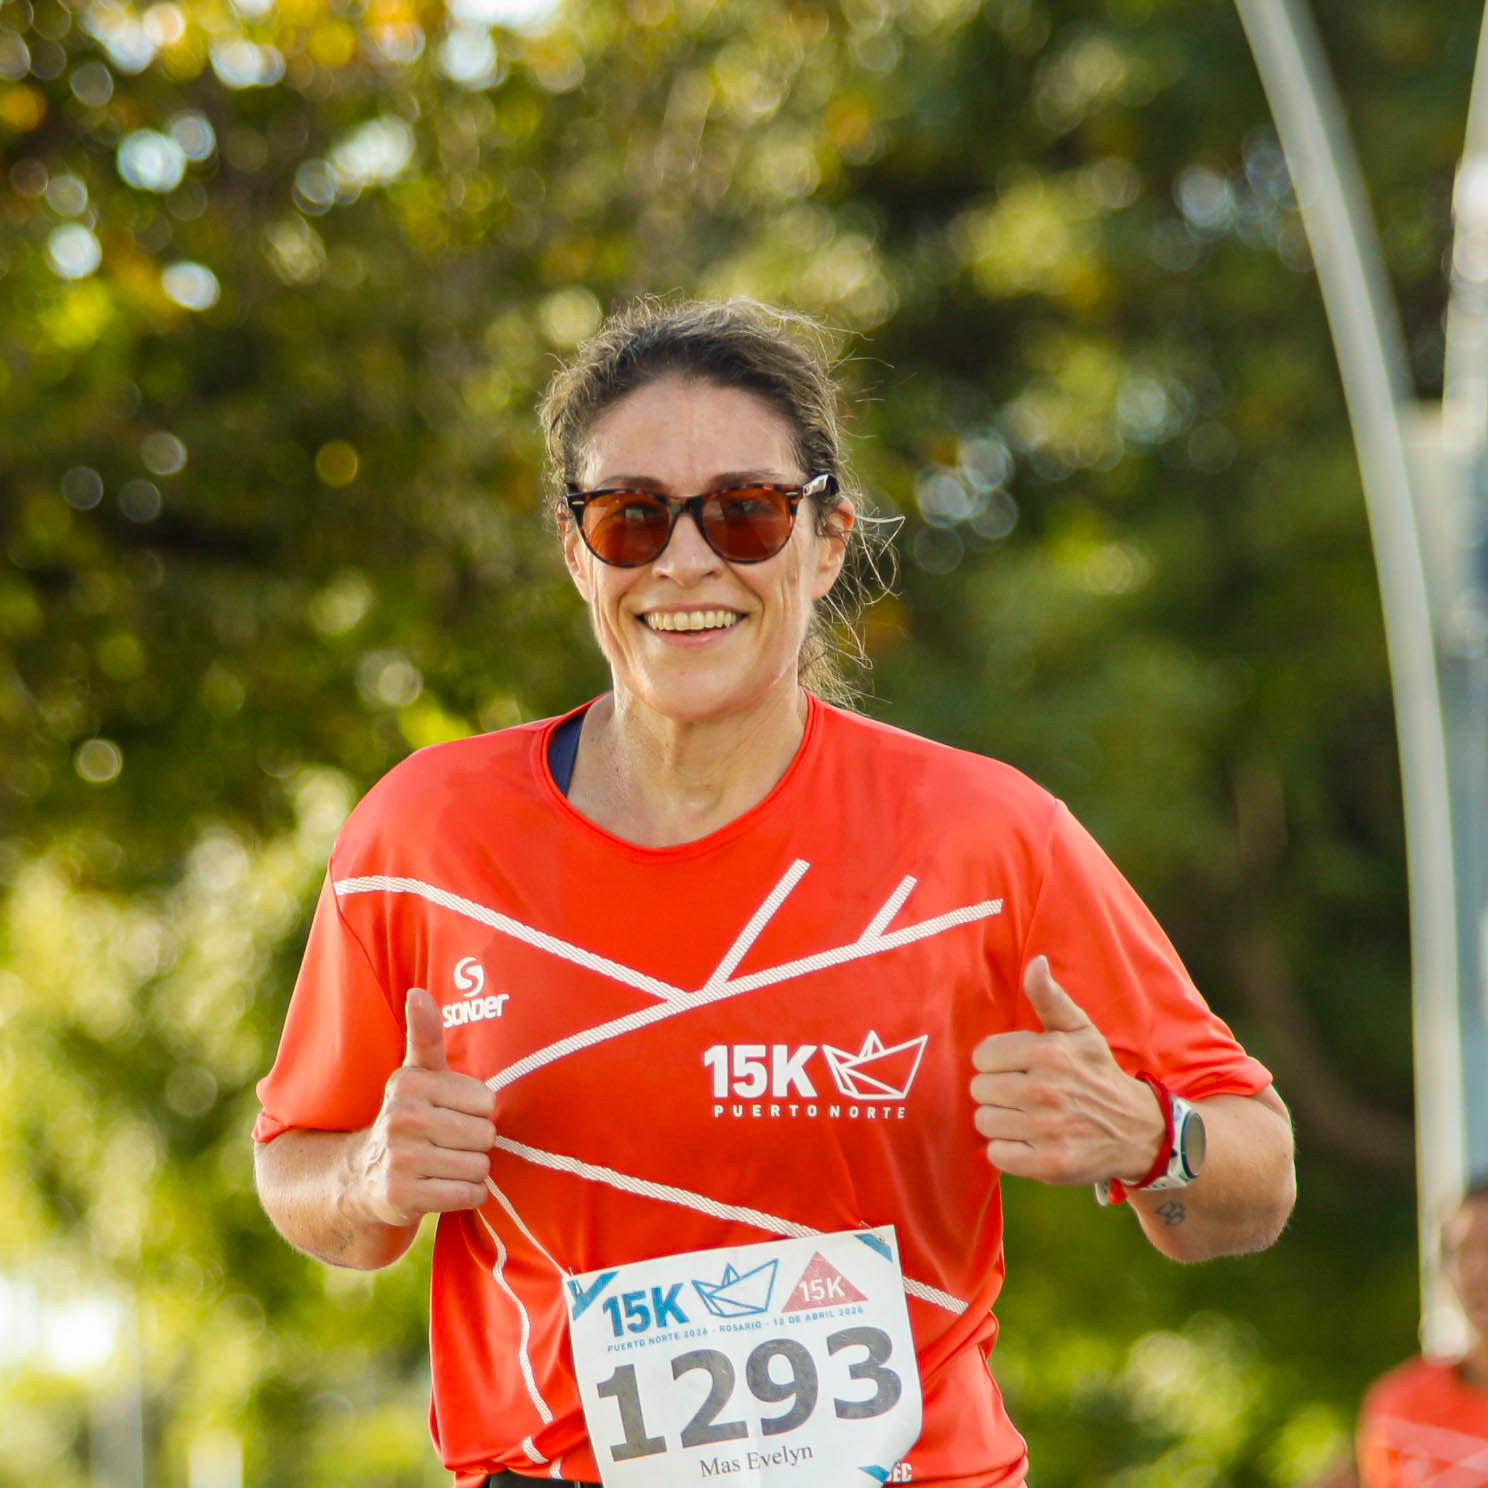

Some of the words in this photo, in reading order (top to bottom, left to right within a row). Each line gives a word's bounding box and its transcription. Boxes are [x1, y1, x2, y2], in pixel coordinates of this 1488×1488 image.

[704, 1045, 818, 1098] 15K
[714, 1104, 818, 1118] PUERTO
[829, 1105, 906, 1119] NORTE
[799, 1275, 847, 1302] 15K
[602, 1283, 690, 1337] 15K
[607, 1337, 646, 1352] PUERTO
[648, 1331, 681, 1345] NORTE
[719, 1320, 762, 1332] ROSARIO
[788, 1314, 801, 1324] DE
[805, 1310, 835, 1322] ABRIL
[596, 1326, 903, 1462] 1293
[699, 1456, 741, 1478] Mas
[746, 1445, 814, 1470] Evelyn
